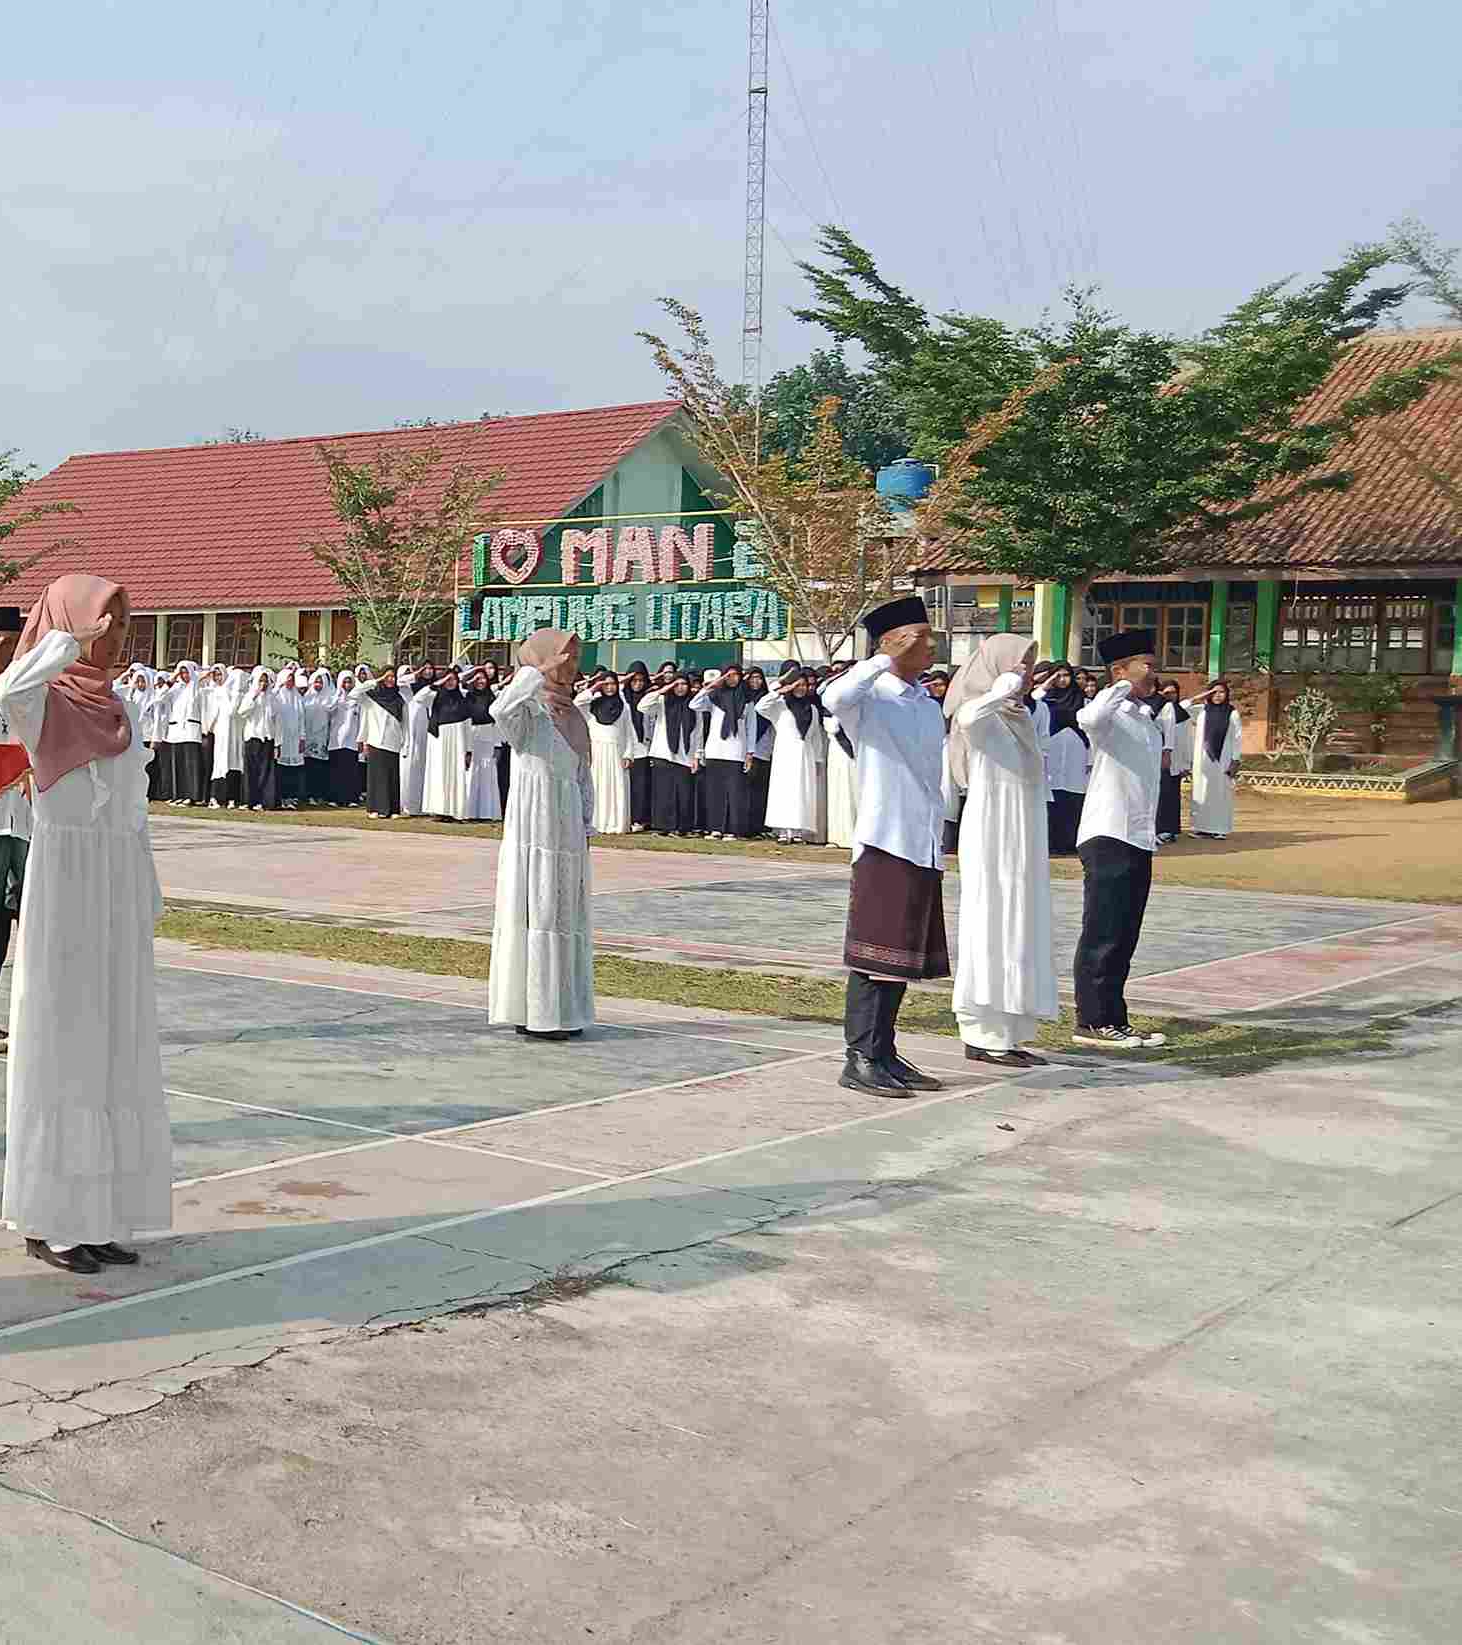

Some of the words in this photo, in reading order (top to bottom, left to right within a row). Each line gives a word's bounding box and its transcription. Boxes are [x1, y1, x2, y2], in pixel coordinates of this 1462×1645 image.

[473, 533, 490, 586] I
[560, 522, 715, 585] MAN
[457, 591, 635, 641] LAMPUNG
[645, 590, 787, 641] UTARA
